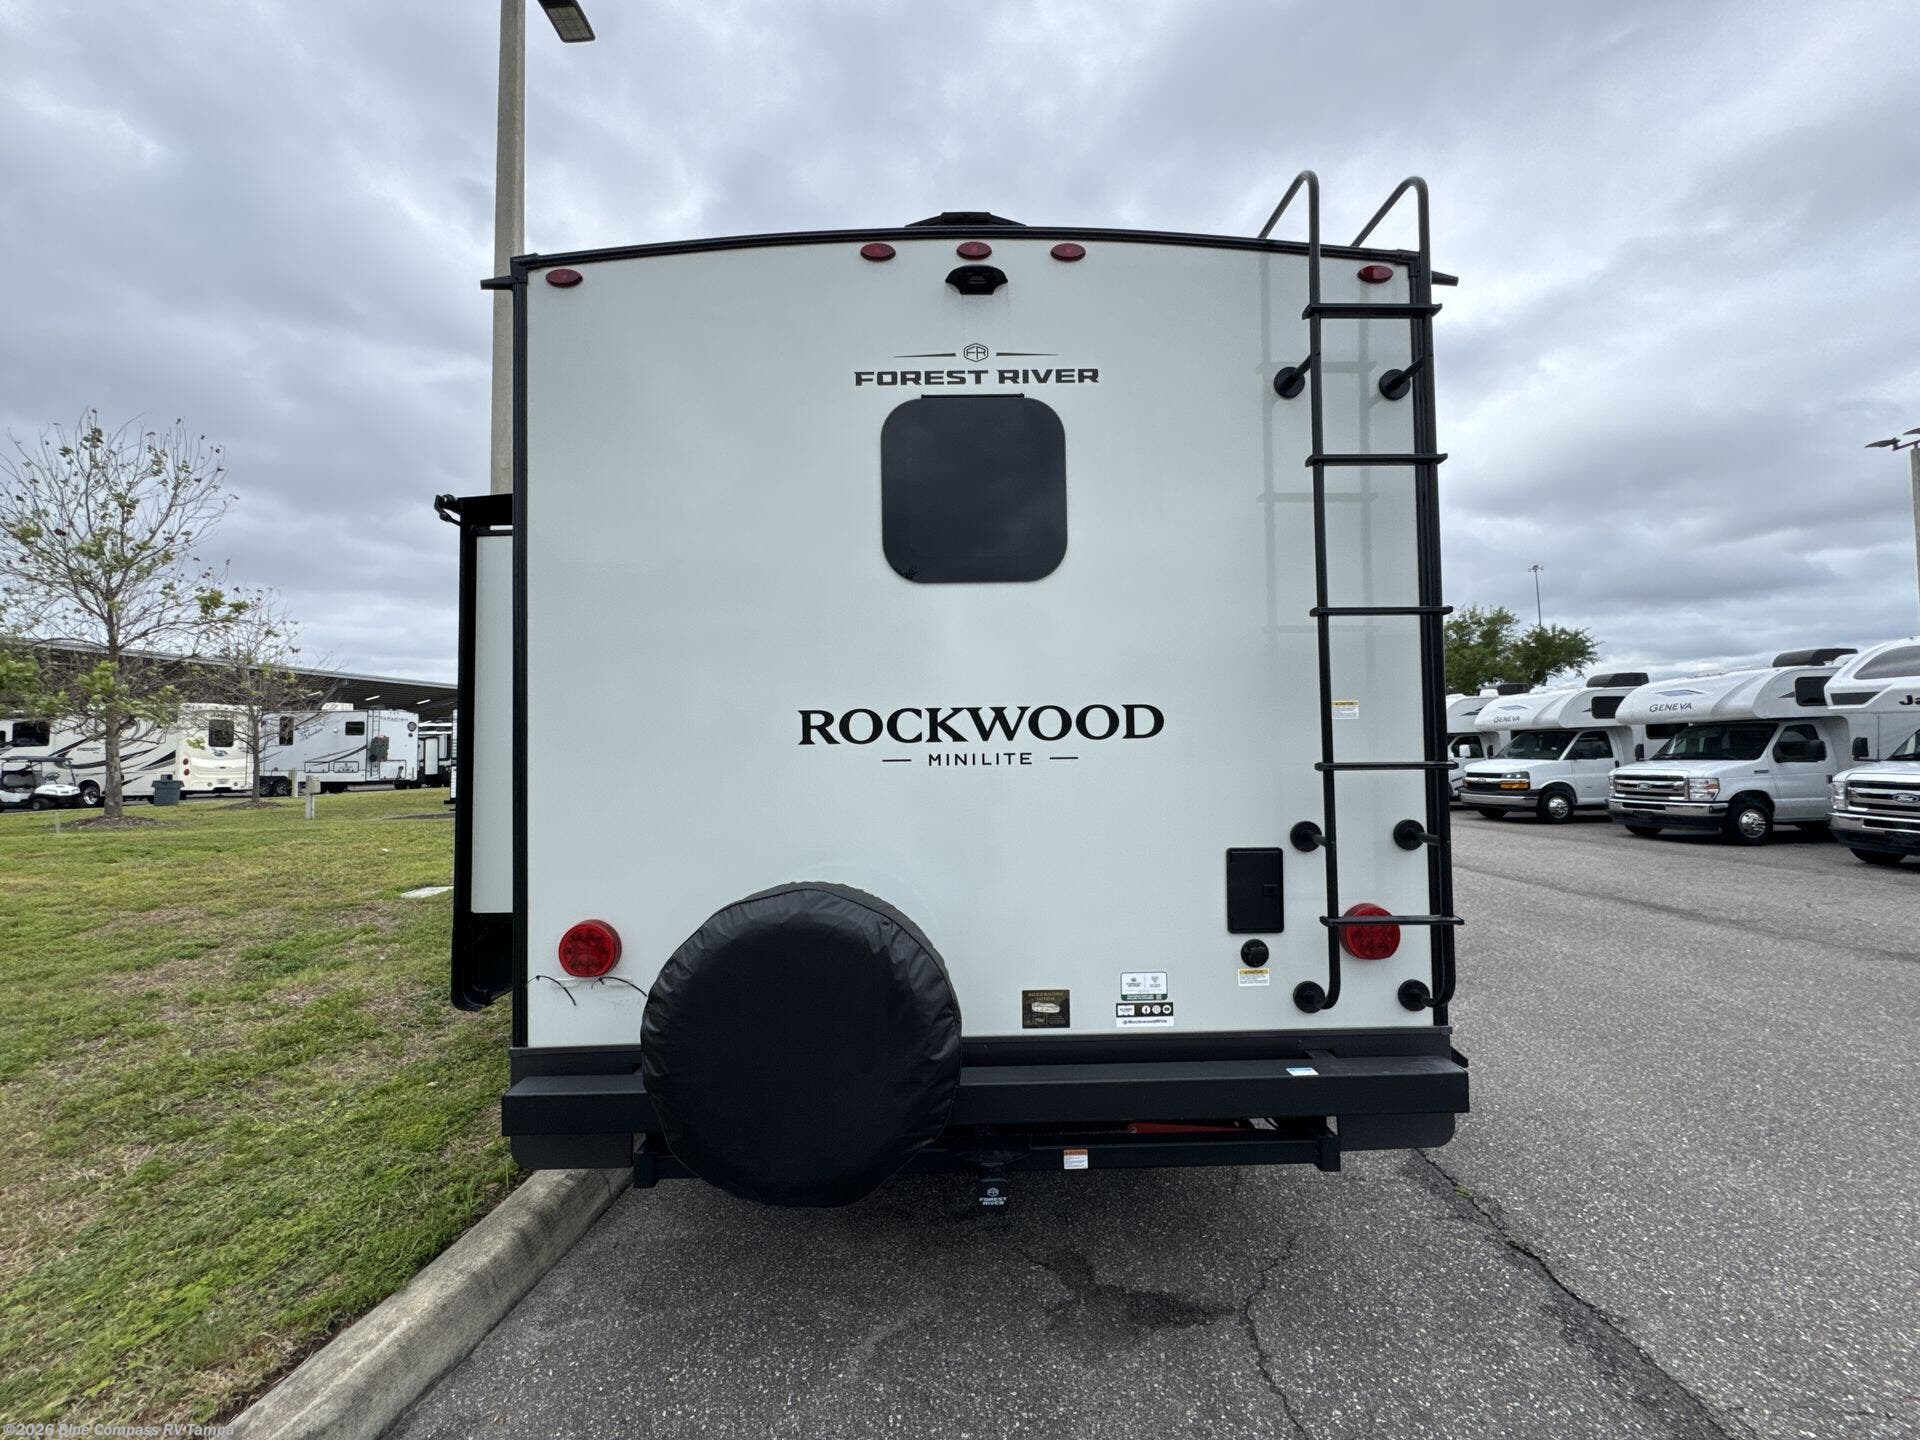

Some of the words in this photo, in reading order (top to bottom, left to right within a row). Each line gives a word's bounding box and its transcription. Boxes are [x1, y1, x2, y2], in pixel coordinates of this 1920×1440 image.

[854, 369, 989, 386] FOREST
[996, 368, 1100, 385] RIVER
[1649, 702, 1692, 713] GENEVA
[798, 704, 1165, 746] ROCKWOOD
[1493, 715, 1520, 724] GENEVA
[928, 752, 1033, 766] MINILITE
